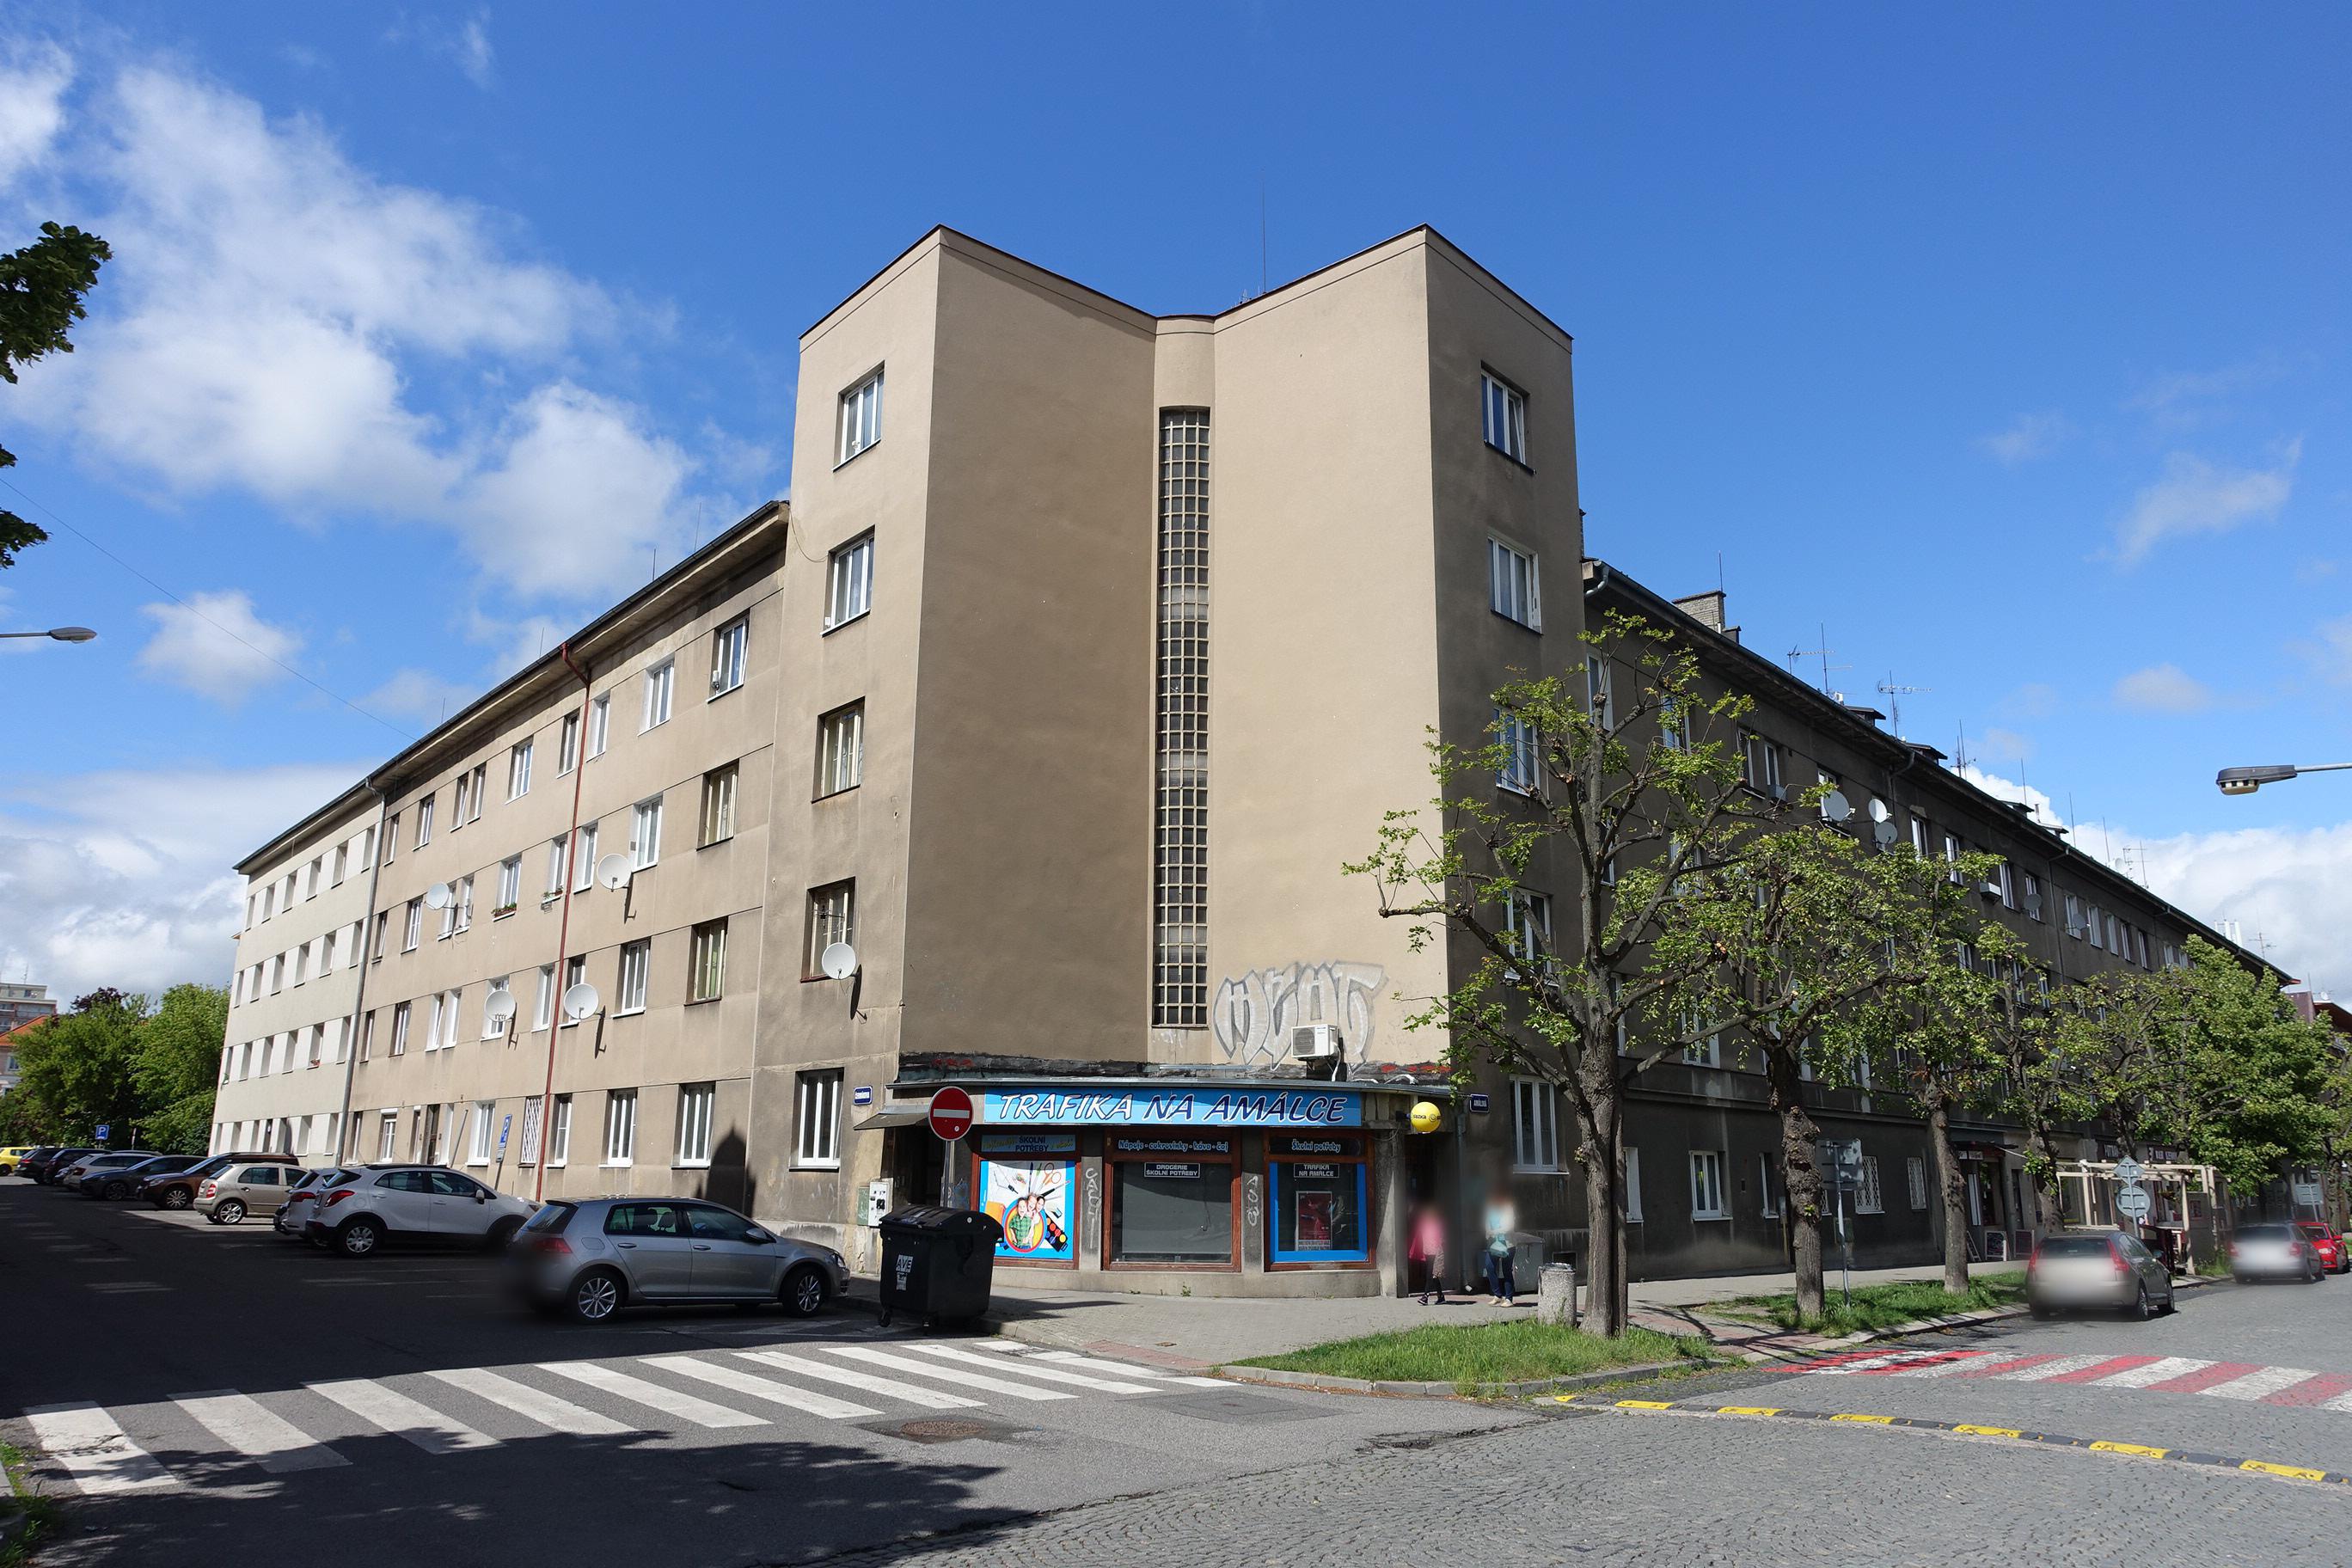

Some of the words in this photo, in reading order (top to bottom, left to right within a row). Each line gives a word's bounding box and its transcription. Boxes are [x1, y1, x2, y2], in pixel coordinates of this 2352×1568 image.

[1000, 1093, 1133, 1119] TRAFIKA
[1142, 1094, 1194, 1121] NA
[1204, 1092, 1348, 1123] AMÁLCE
[1015, 1143, 1049, 1152] POTŘEBY
[1118, 1140, 1144, 1151] Nápoje
[1148, 1141, 1188, 1152] cukrovinky
[1193, 1141, 1211, 1150] káva
[1216, 1141, 1228, 1153] čaj
[1292, 1138, 1314, 1151] Školní
[1314, 1142, 1341, 1153] potřeby
